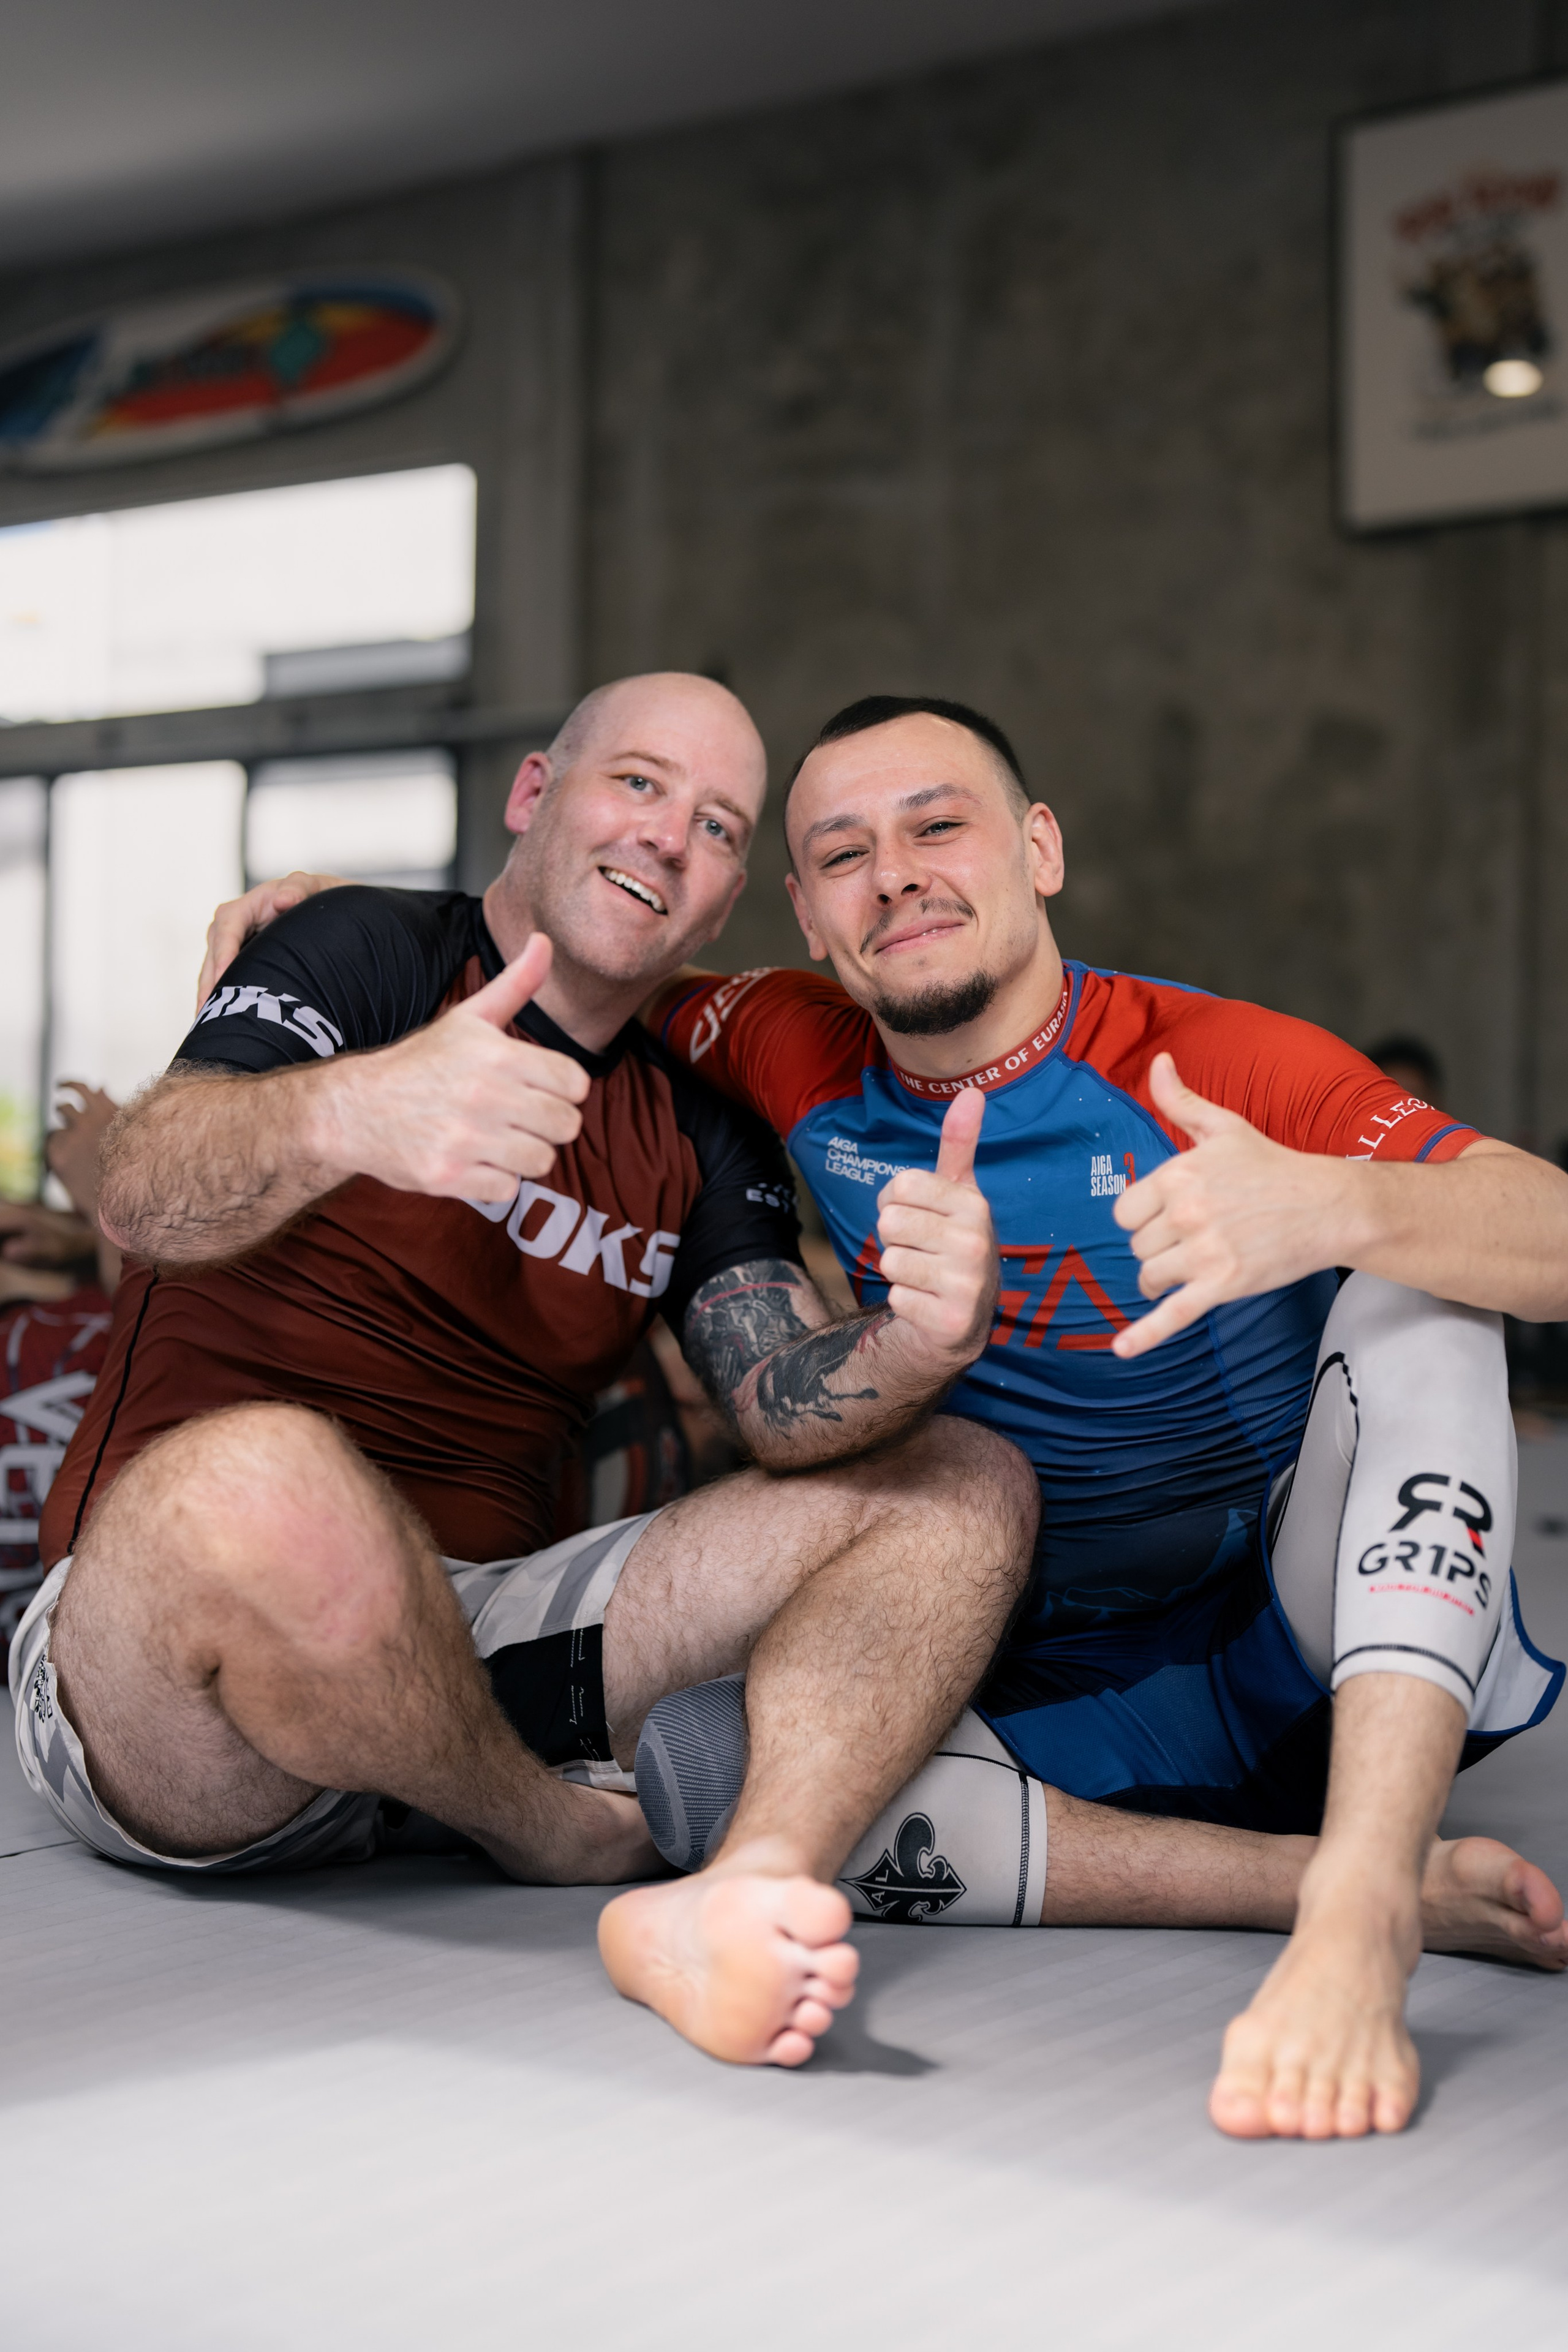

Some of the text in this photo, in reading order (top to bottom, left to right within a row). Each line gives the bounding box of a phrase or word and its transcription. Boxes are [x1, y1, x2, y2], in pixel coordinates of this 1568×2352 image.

[899, 1070, 925, 1091] THE
[928, 1067, 1001, 1094] CENTER
[1005, 1047, 1029, 1070] OF
[827, 1136, 858, 1154] AIGA
[826, 1159, 875, 1185] LEAGUE
[1091, 1155, 1112, 1176] AIGA
[1091, 1152, 1136, 1197] SEASON 3
